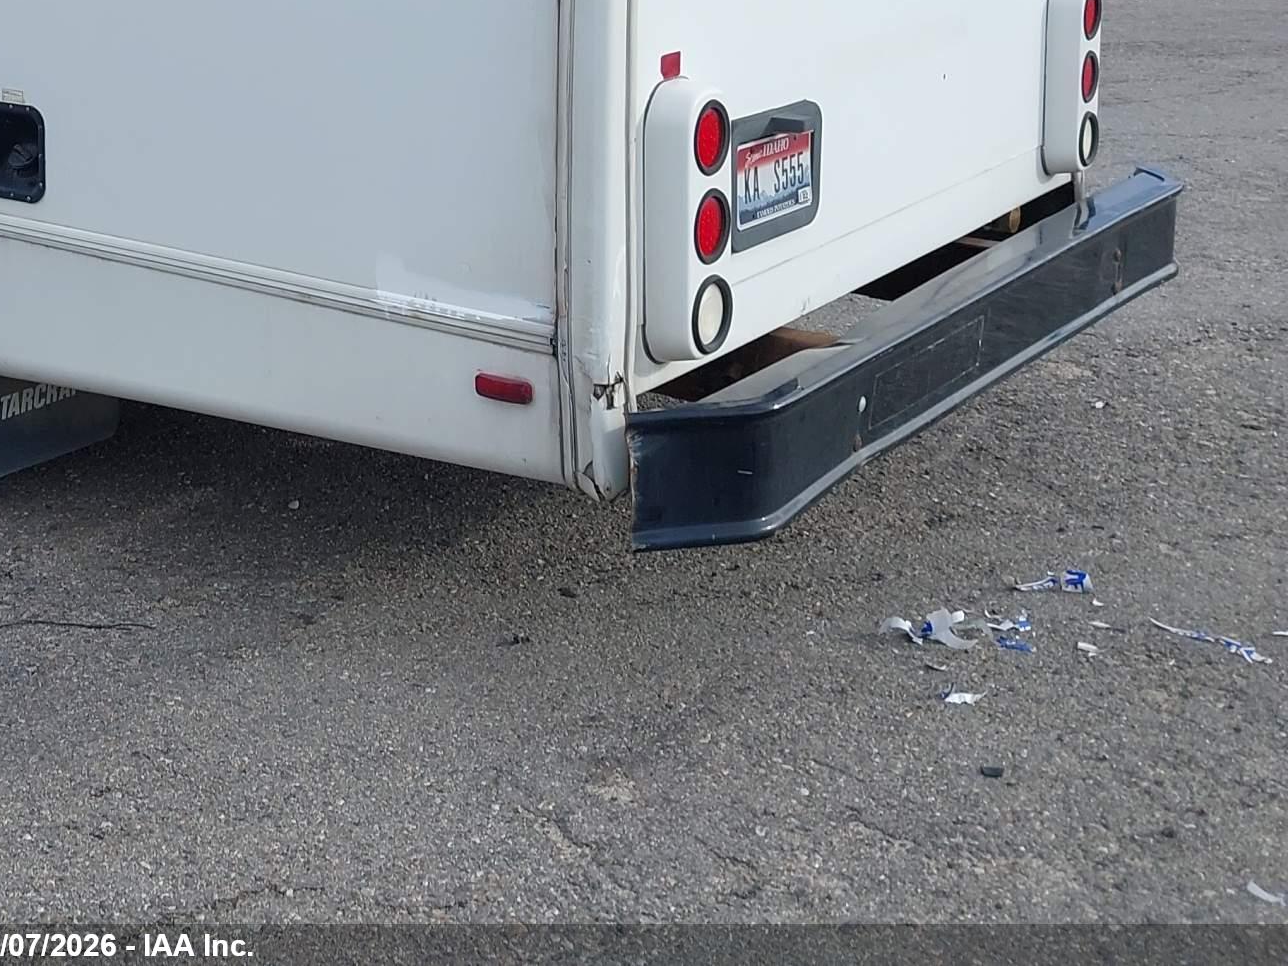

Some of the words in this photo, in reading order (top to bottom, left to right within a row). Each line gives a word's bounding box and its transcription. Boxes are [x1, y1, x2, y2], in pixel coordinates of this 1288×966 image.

[763, 137, 789, 156] IDAHO
[744, 166, 760, 204] KA
[774, 152, 804, 193] S555
